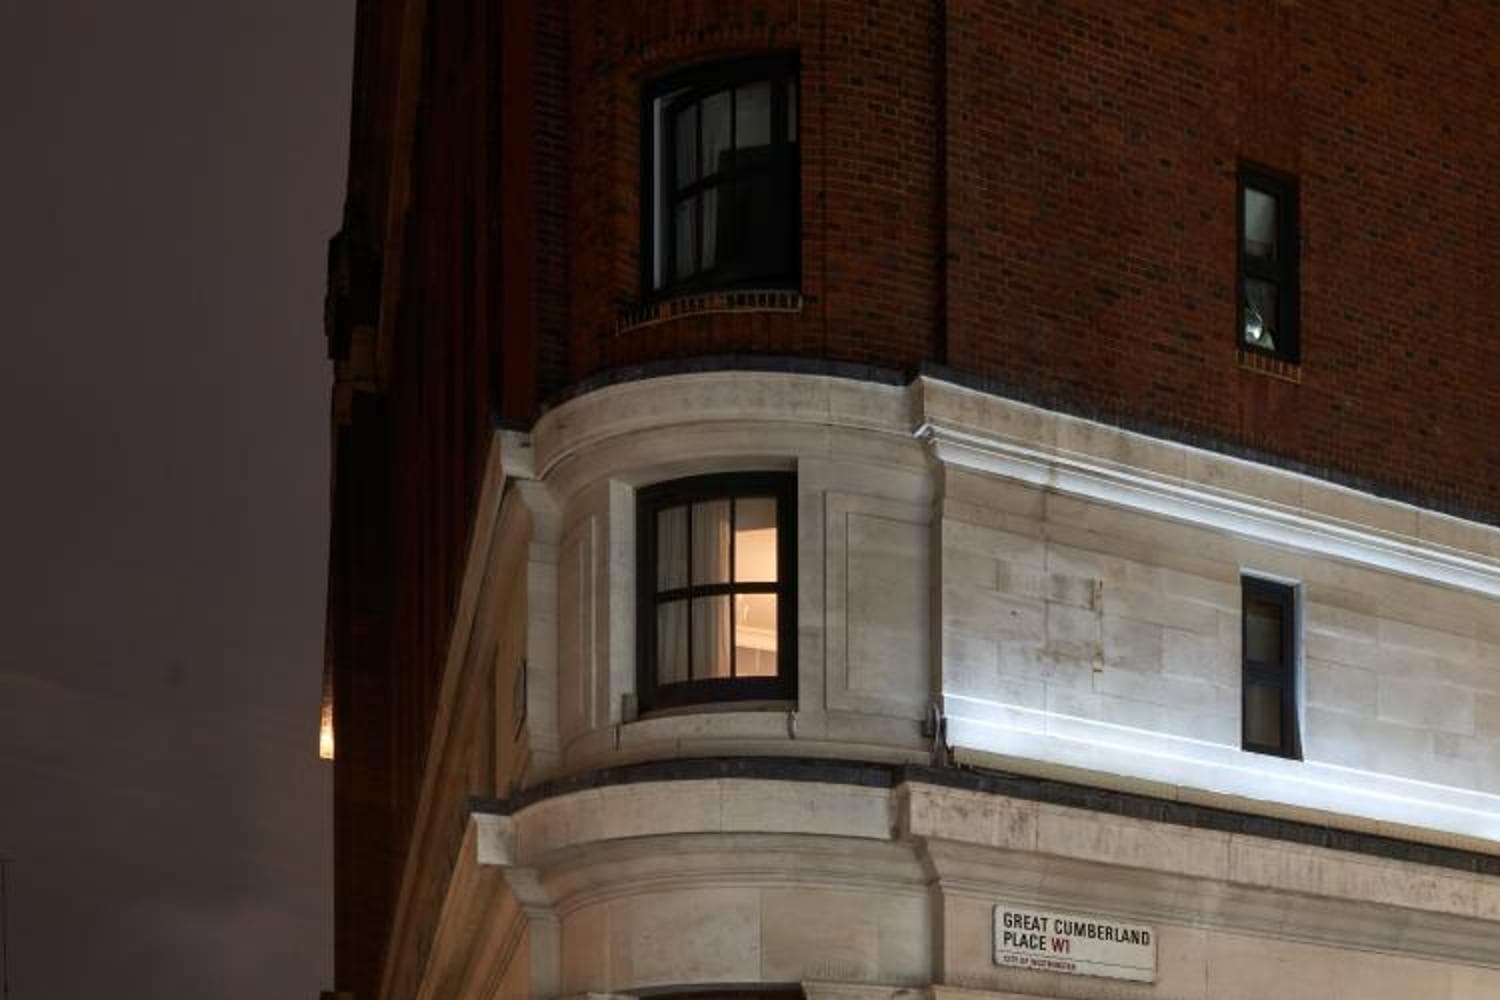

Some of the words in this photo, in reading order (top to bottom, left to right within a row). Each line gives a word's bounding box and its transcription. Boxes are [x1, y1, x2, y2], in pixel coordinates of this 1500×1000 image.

[1003, 912, 1049, 932] GREAT
[1054, 919, 1150, 946] CUMBERLAND
[1003, 931, 1047, 951] PLACE
[1051, 937, 1071, 954] W1
